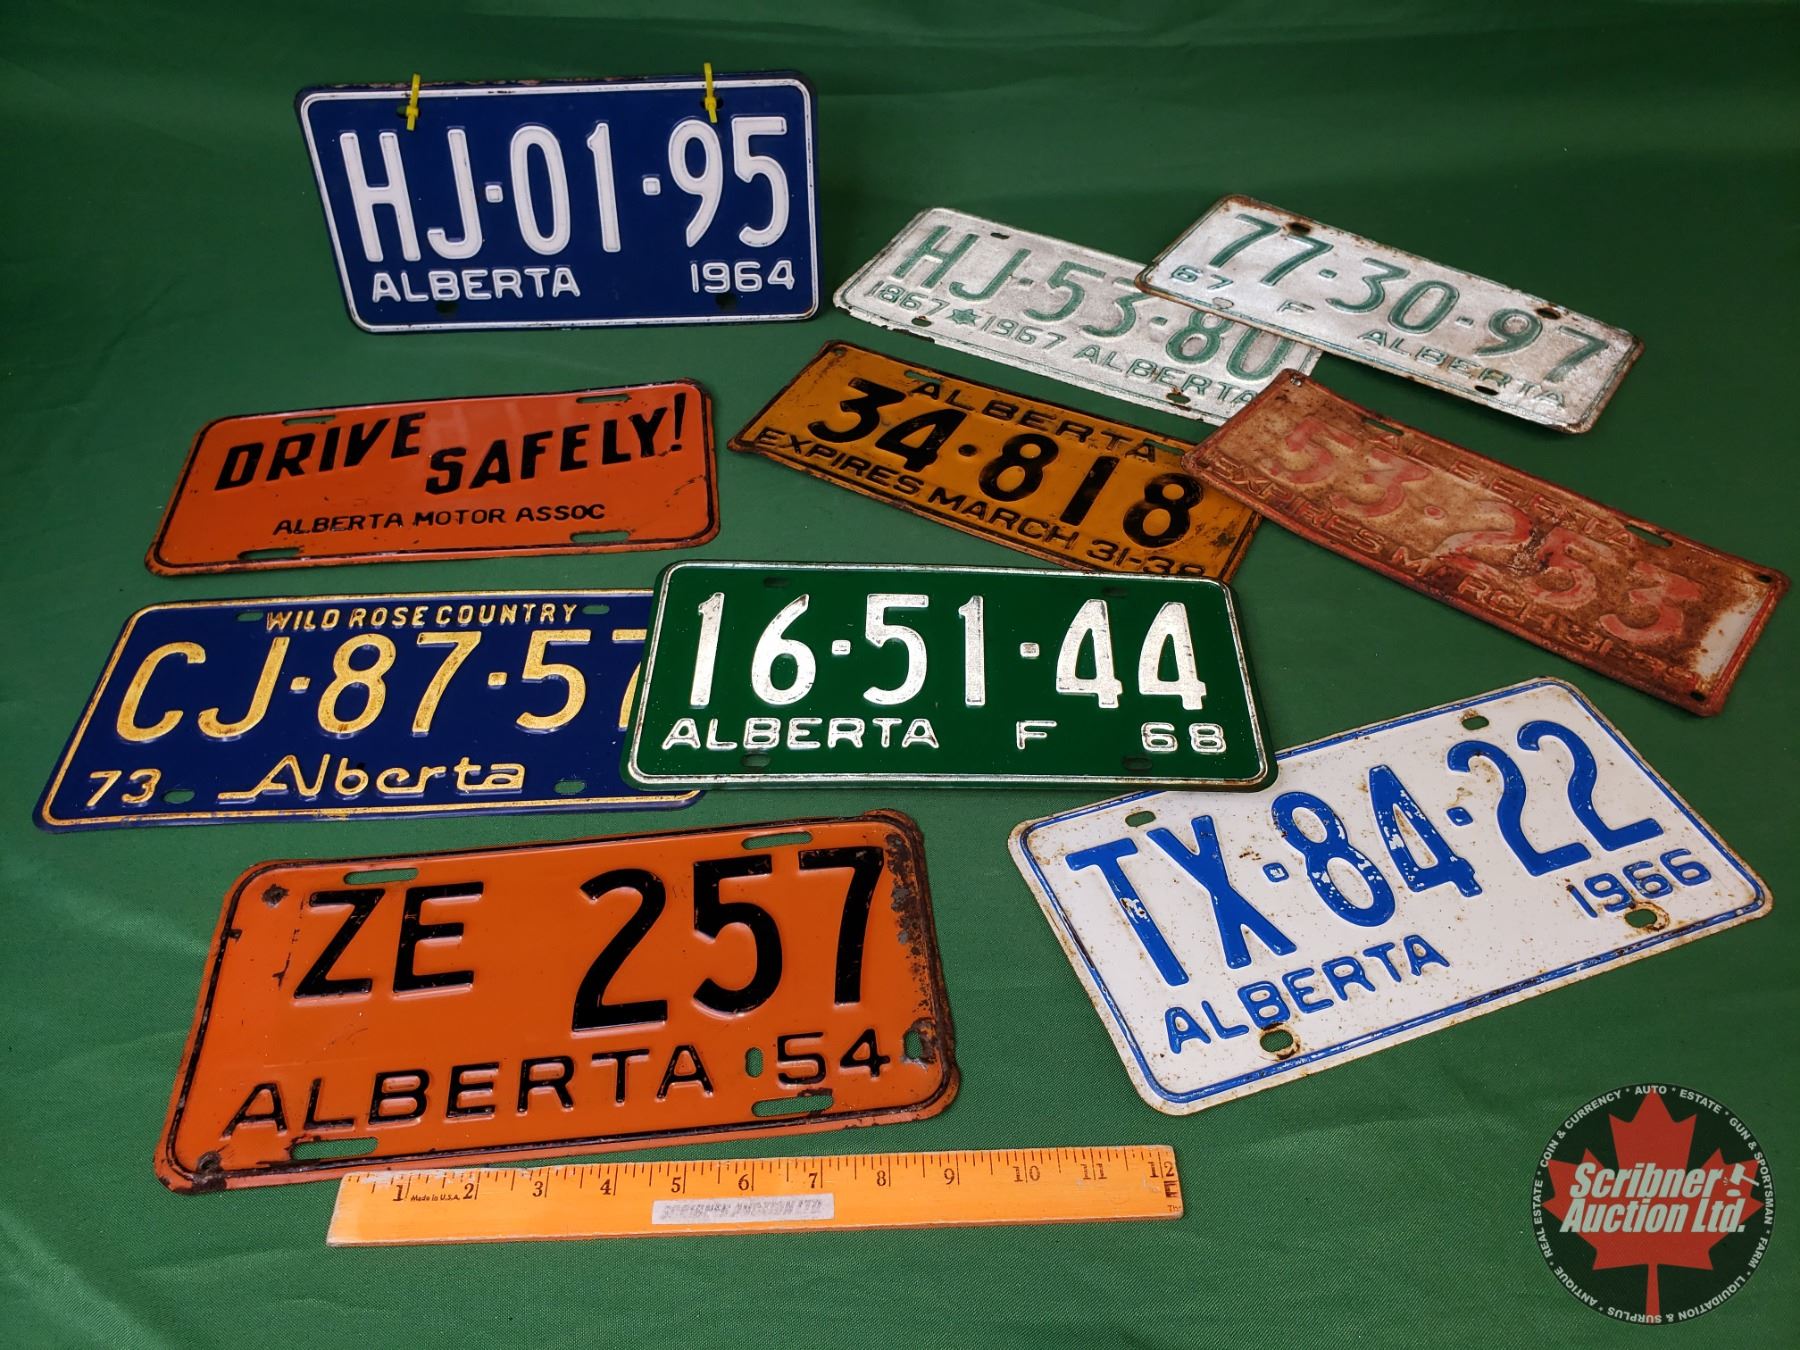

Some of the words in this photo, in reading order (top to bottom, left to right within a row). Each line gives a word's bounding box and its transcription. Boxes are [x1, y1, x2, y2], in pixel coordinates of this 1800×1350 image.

[372, 266, 581, 303] ALBERTA
[689, 259, 795, 294] 1964
[1170, 263, 1234, 291] 67
[864, 280, 951, 316] 1867
[979, 314, 1067, 351] 1967
[1276, 299, 1316, 316] F
[1073, 344, 1258, 406] ALBERTA
[1357, 327, 1568, 410] ALBERTA
[214, 412, 427, 491] DRIVE
[425, 392, 688, 495] SAFELY!
[907, 380, 1158, 464] ALBERTA
[757, 426, 924, 498] EXPIRES
[926, 487, 1080, 552] MARCH
[272, 512, 402, 535] ALBERTA
[413, 508, 505, 527] MOTOR
[516, 503, 606, 523] ASSOC
[266, 607, 341, 631] WILD
[348, 605, 426, 628] ROSE
[435, 603, 578, 627] COUNTRY
[662, 717, 941, 751] ALBERTA
[1016, 720, 1058, 750] F
[1141, 721, 1228, 755] 68
[87, 768, 162, 809] 73
[217, 753, 525, 804] Alberta
[1565, 848, 1713, 919] 1966
[293, 881, 484, 998] ZE
[571, 845, 884, 1033] 257
[1163, 934, 1450, 1054] ALBERTA
[220, 1043, 714, 1140] ALBERTA
[776, 1028, 890, 1087] 54
[392, 1184, 404, 1201] 1
[463, 1182, 474, 1200] 2
[533, 1181, 544, 1198] 3
[600, 1178, 611, 1196] 4
[671, 1177, 682, 1194] 5
[737, 1174, 749, 1191] 6
[808, 1172, 818, 1189] 7
[876, 1170, 887, 1187] 8
[944, 1168, 955, 1185] 9
[1014, 1165, 1040, 1183] 10
[1080, 1163, 1107, 1180] 11
[1148, 1160, 1175, 1178] 12
